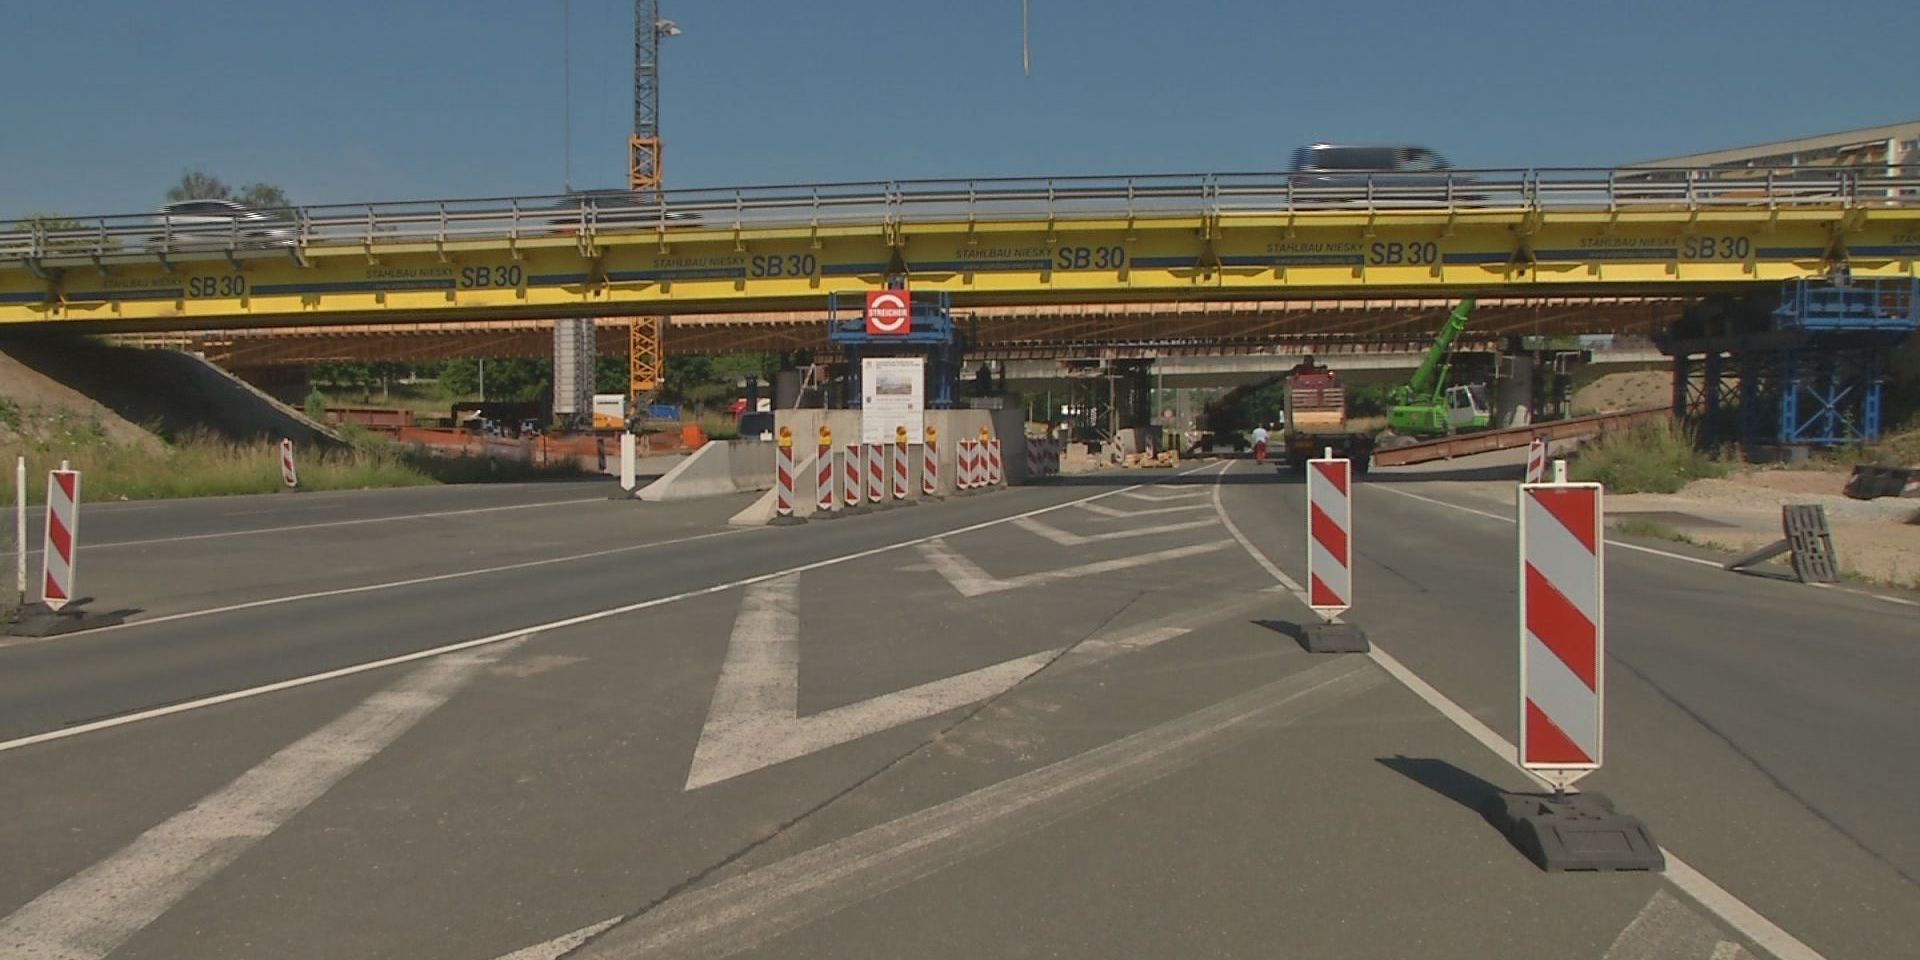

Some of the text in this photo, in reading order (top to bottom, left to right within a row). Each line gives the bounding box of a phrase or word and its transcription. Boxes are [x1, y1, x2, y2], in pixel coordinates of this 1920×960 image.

[956, 248, 1011, 259] STAHLBAU
[1266, 242, 1363, 253] STAHLBAU NIESKY
[1370, 242, 1438, 265] SB 30
[1580, 237, 1636, 248] STAHLBAU
[1683, 236, 1750, 259] SB 30
[653, 258, 706, 268] STAHLBAU
[751, 255, 783, 277] SB
[787, 254, 817, 276] 30
[1057, 246, 1125, 269] SB 30
[189, 275, 246, 298] SB 30
[461, 266, 490, 288] SB
[494, 265, 522, 287] 30
